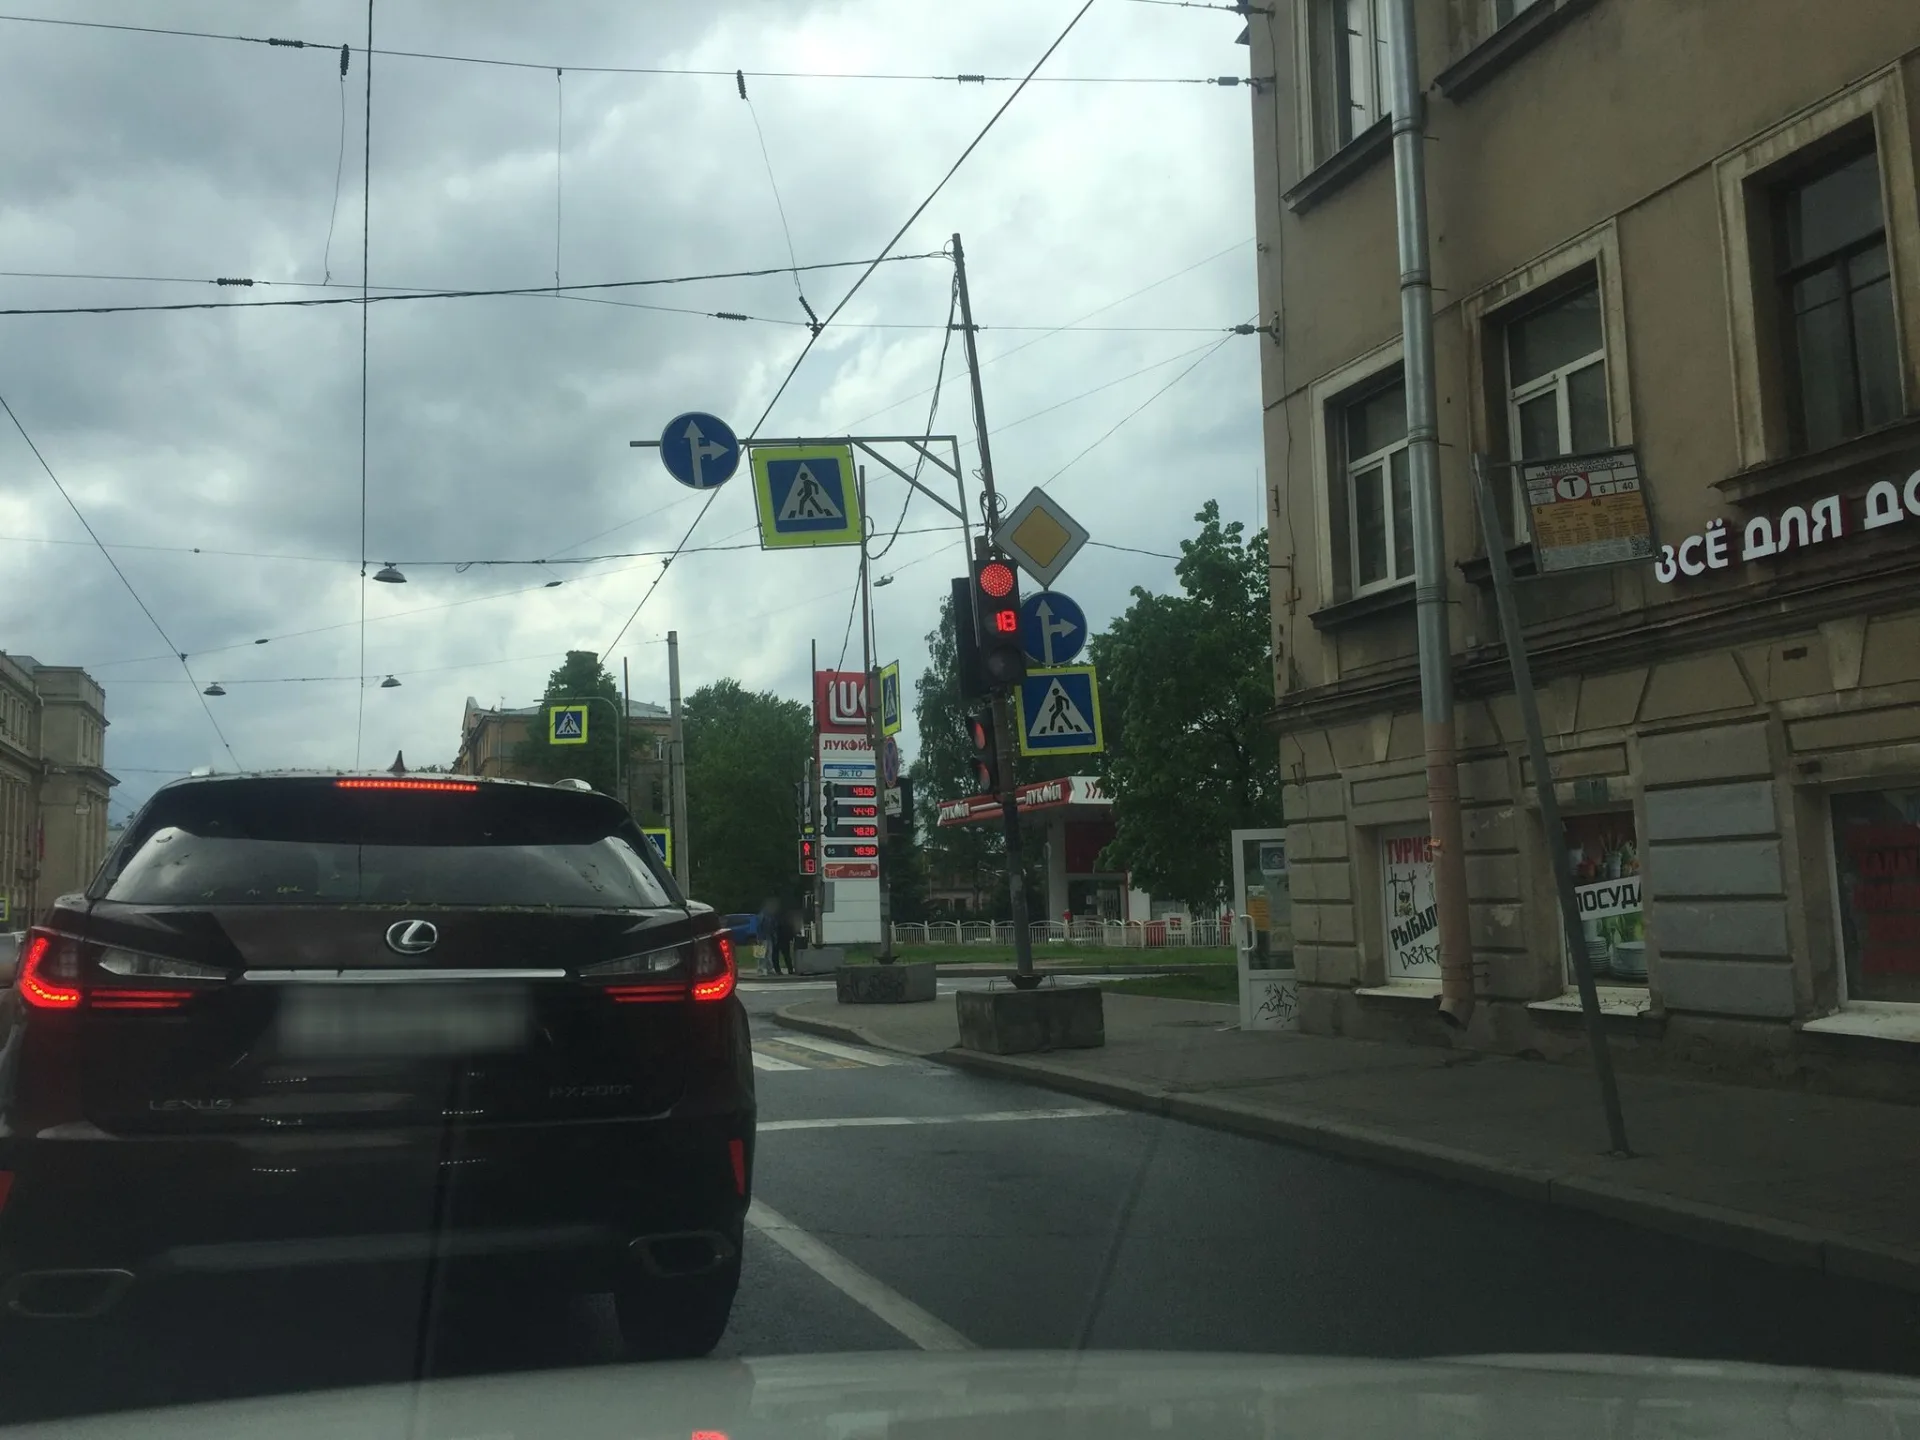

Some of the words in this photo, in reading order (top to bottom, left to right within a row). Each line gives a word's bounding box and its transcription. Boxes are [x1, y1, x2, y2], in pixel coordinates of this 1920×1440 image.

[1563, 477, 1579, 497] Т
[1600, 485, 1606, 494] 6
[1622, 481, 1634, 491] 40
[1654, 517, 1729, 584] ВСЁ
[1742, 494, 1843, 561] ДЛЯ
[996, 610, 1017, 632] 18
[838, 769, 863, 778] ЭКТО
[1390, 903, 1438, 951] РЫБАЛ
[149, 1098, 233, 1111] LEXUS
